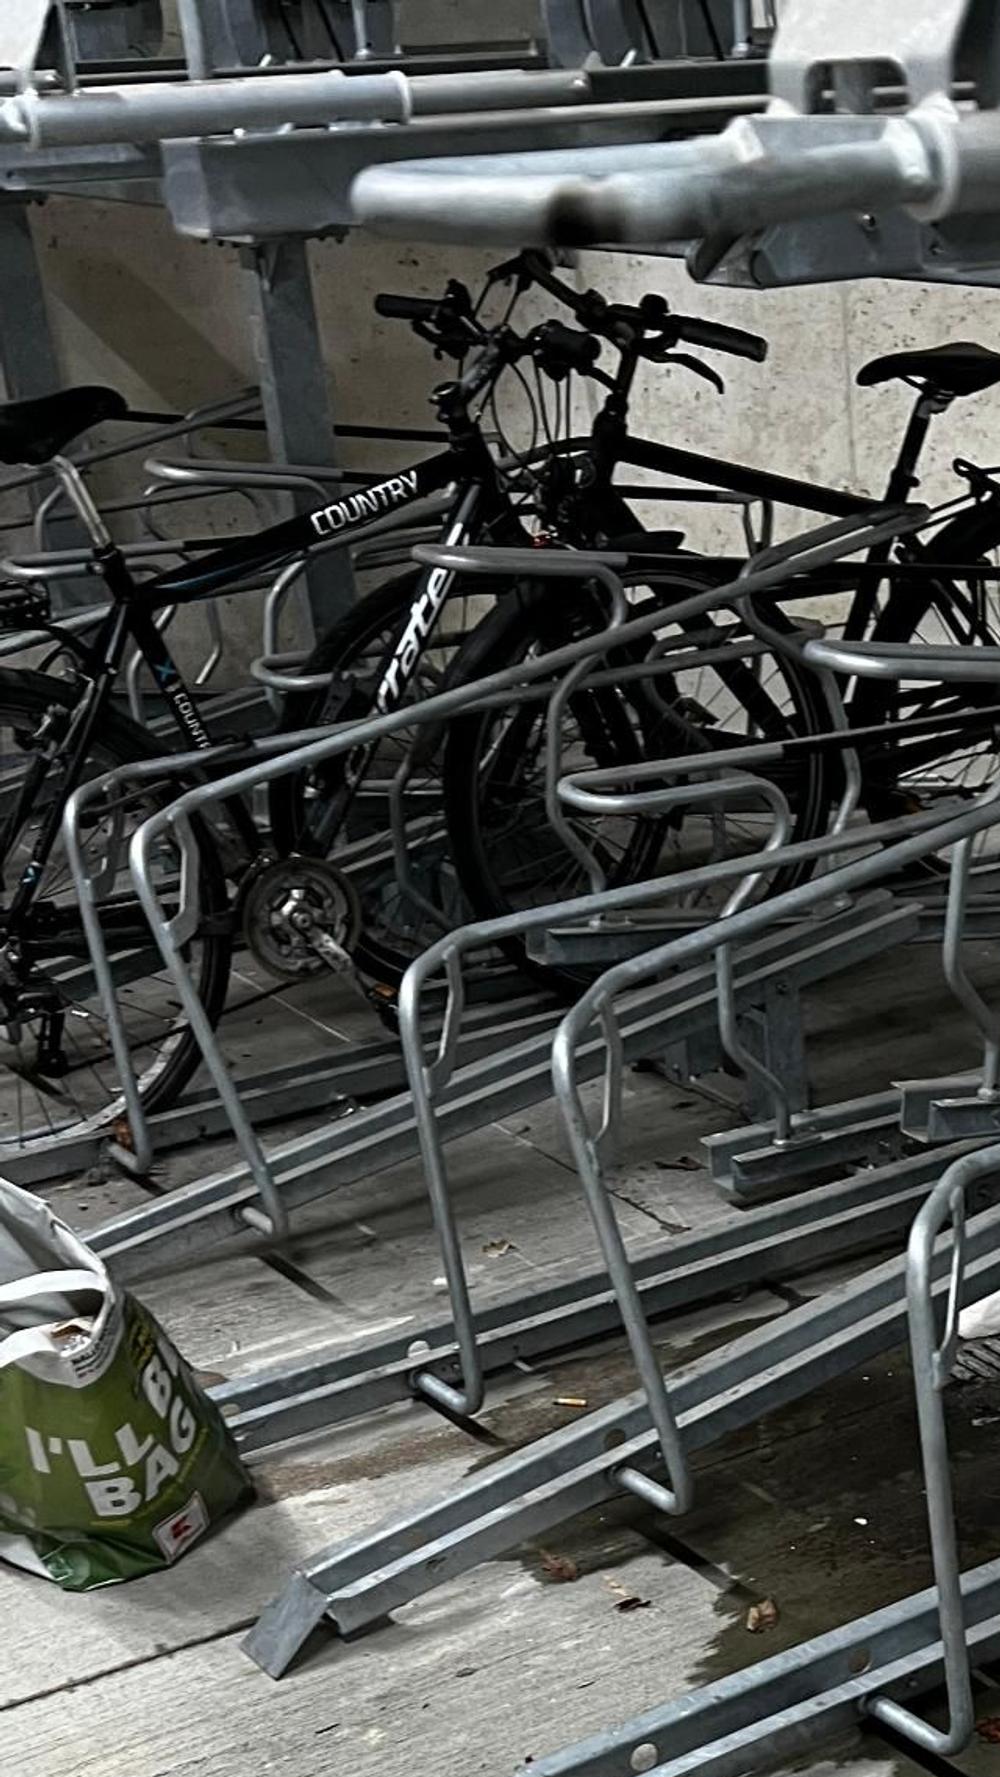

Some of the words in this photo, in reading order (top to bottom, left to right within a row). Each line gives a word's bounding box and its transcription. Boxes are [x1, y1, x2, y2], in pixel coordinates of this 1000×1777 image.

[310, 470, 417, 535] COUNTRY
[25, 1422, 154, 1477] I'LL
[84, 1396, 197, 1517] BAG
